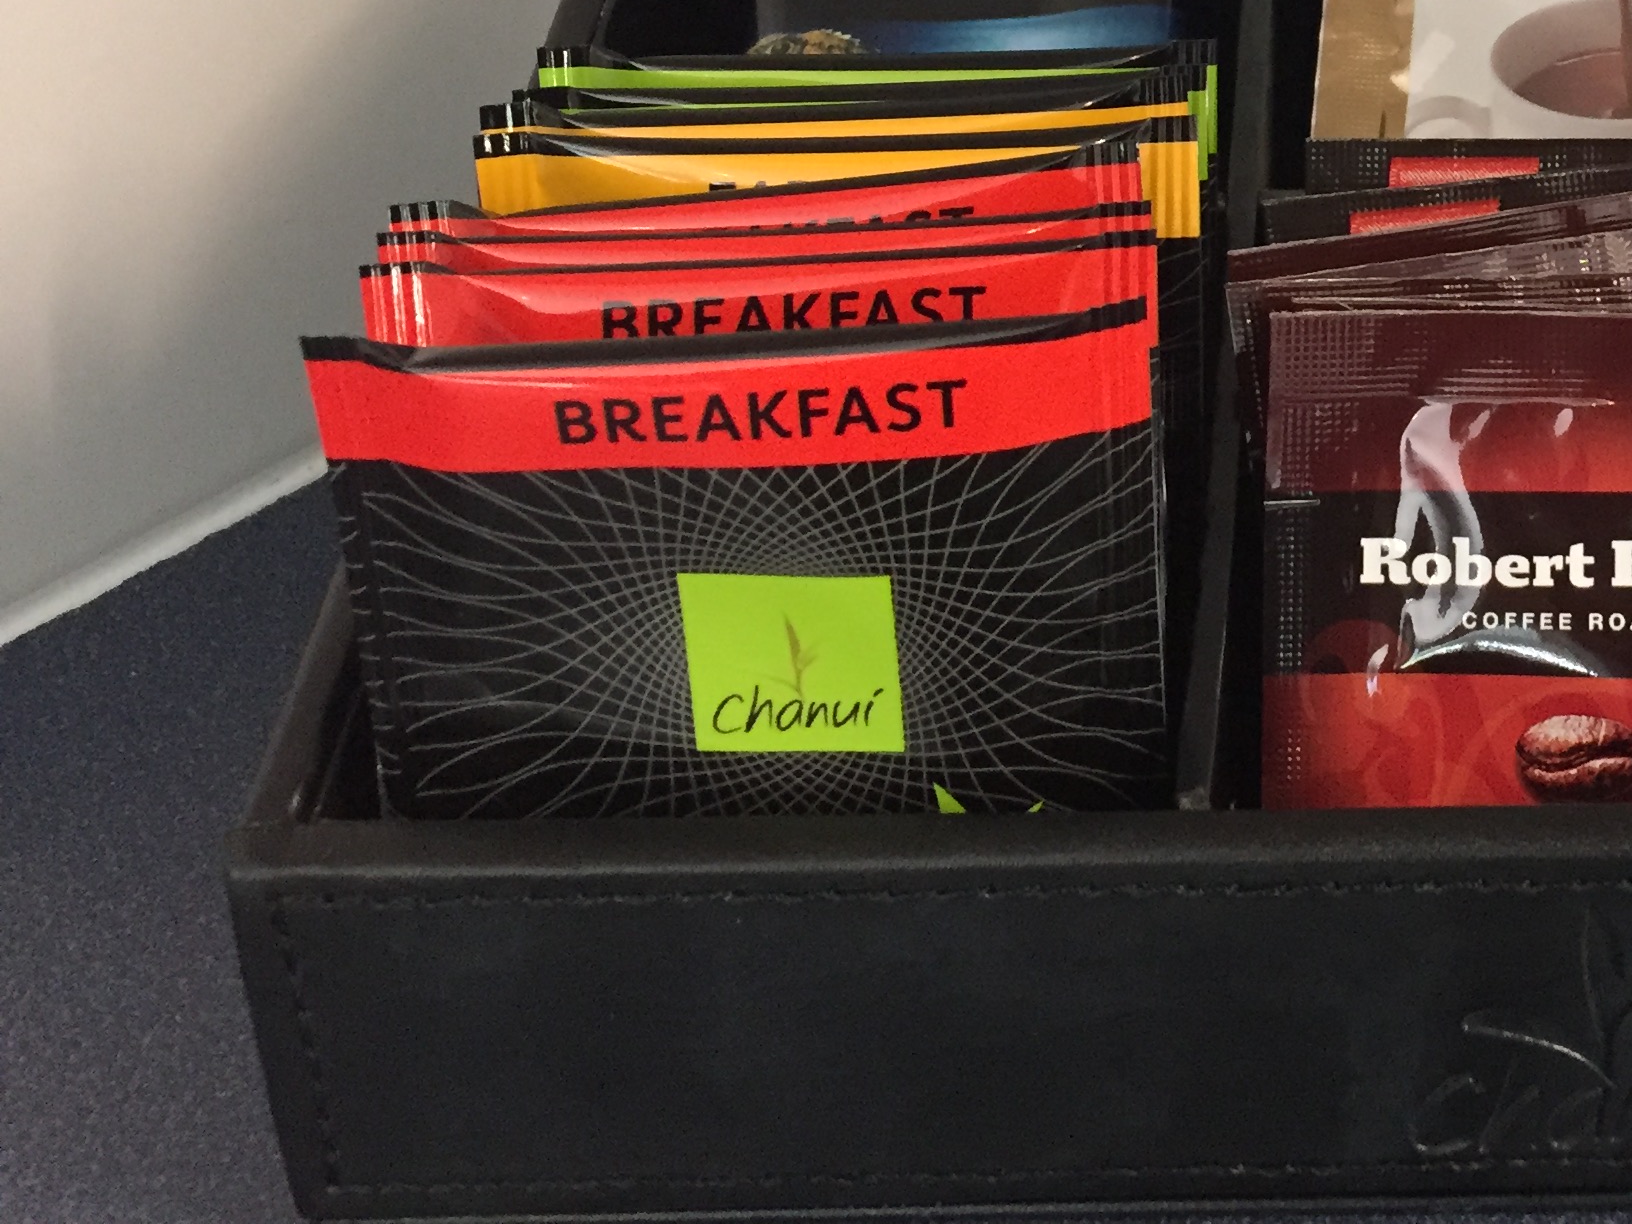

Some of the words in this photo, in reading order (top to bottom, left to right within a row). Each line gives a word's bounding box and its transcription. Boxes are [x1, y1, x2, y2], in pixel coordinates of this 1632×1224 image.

[554, 378, 968, 445] BREAKFAST
[1359, 537, 1596, 589] Robert
[1461, 612, 1573, 632] COFFEE
